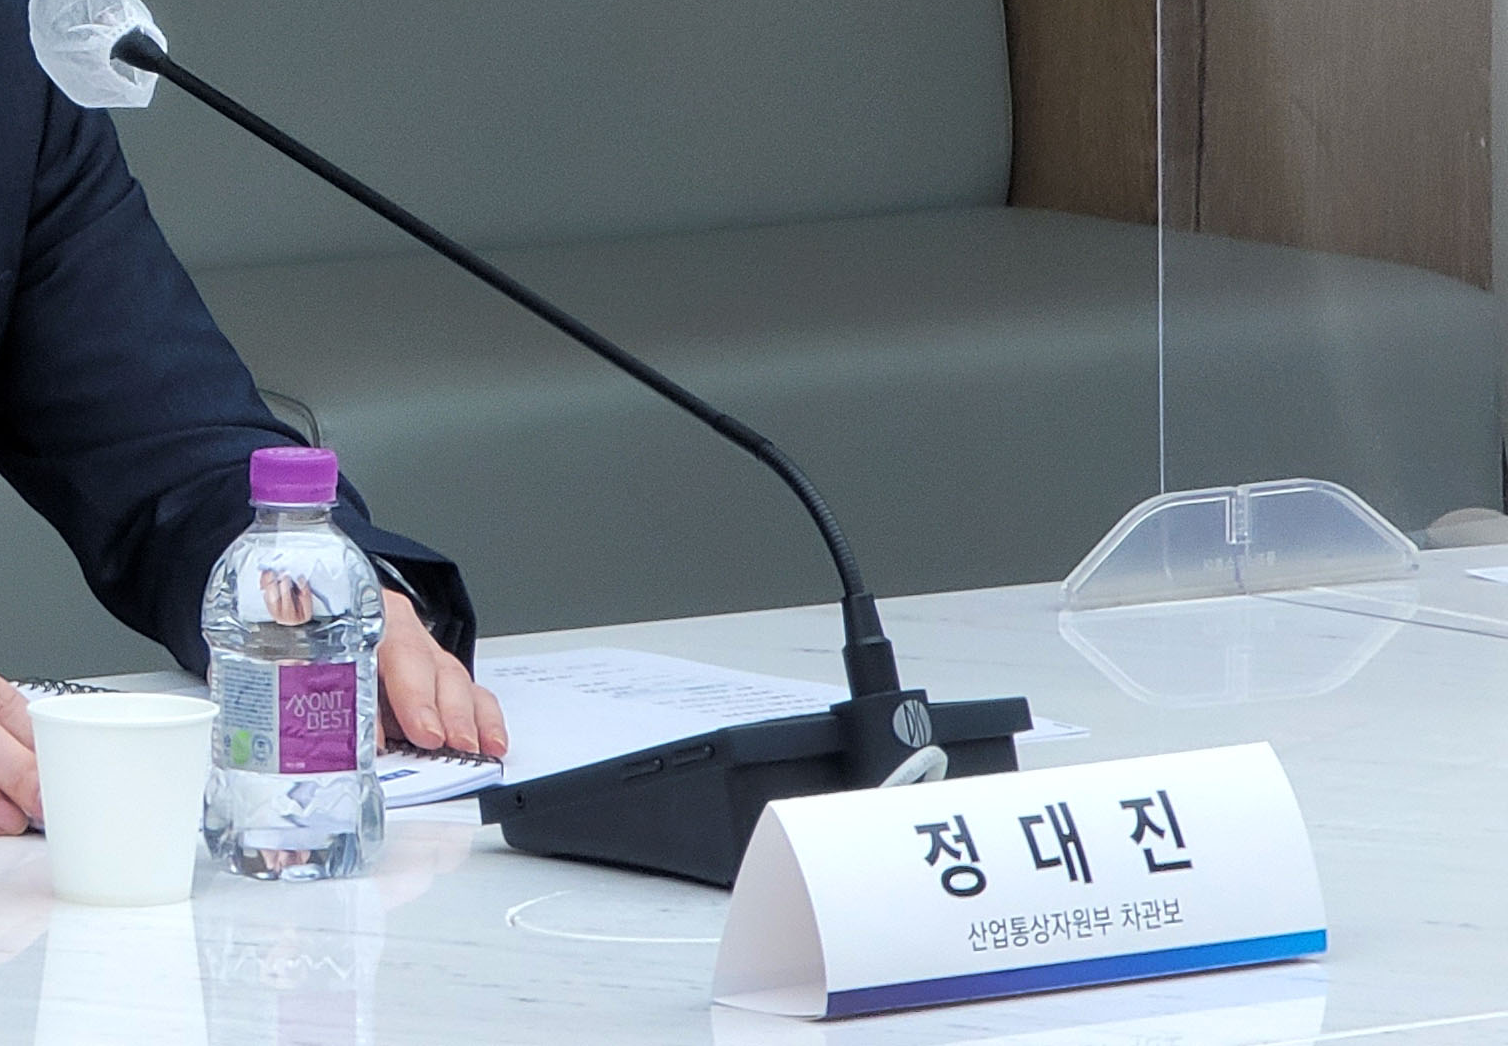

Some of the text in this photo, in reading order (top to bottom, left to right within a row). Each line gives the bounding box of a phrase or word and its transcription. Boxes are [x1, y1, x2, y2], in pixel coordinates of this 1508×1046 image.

[285, 690, 345, 718] MONT
[307, 708, 352, 731] BEST
[967, 897, 1184, 952] 산업통상자원부 차관보
